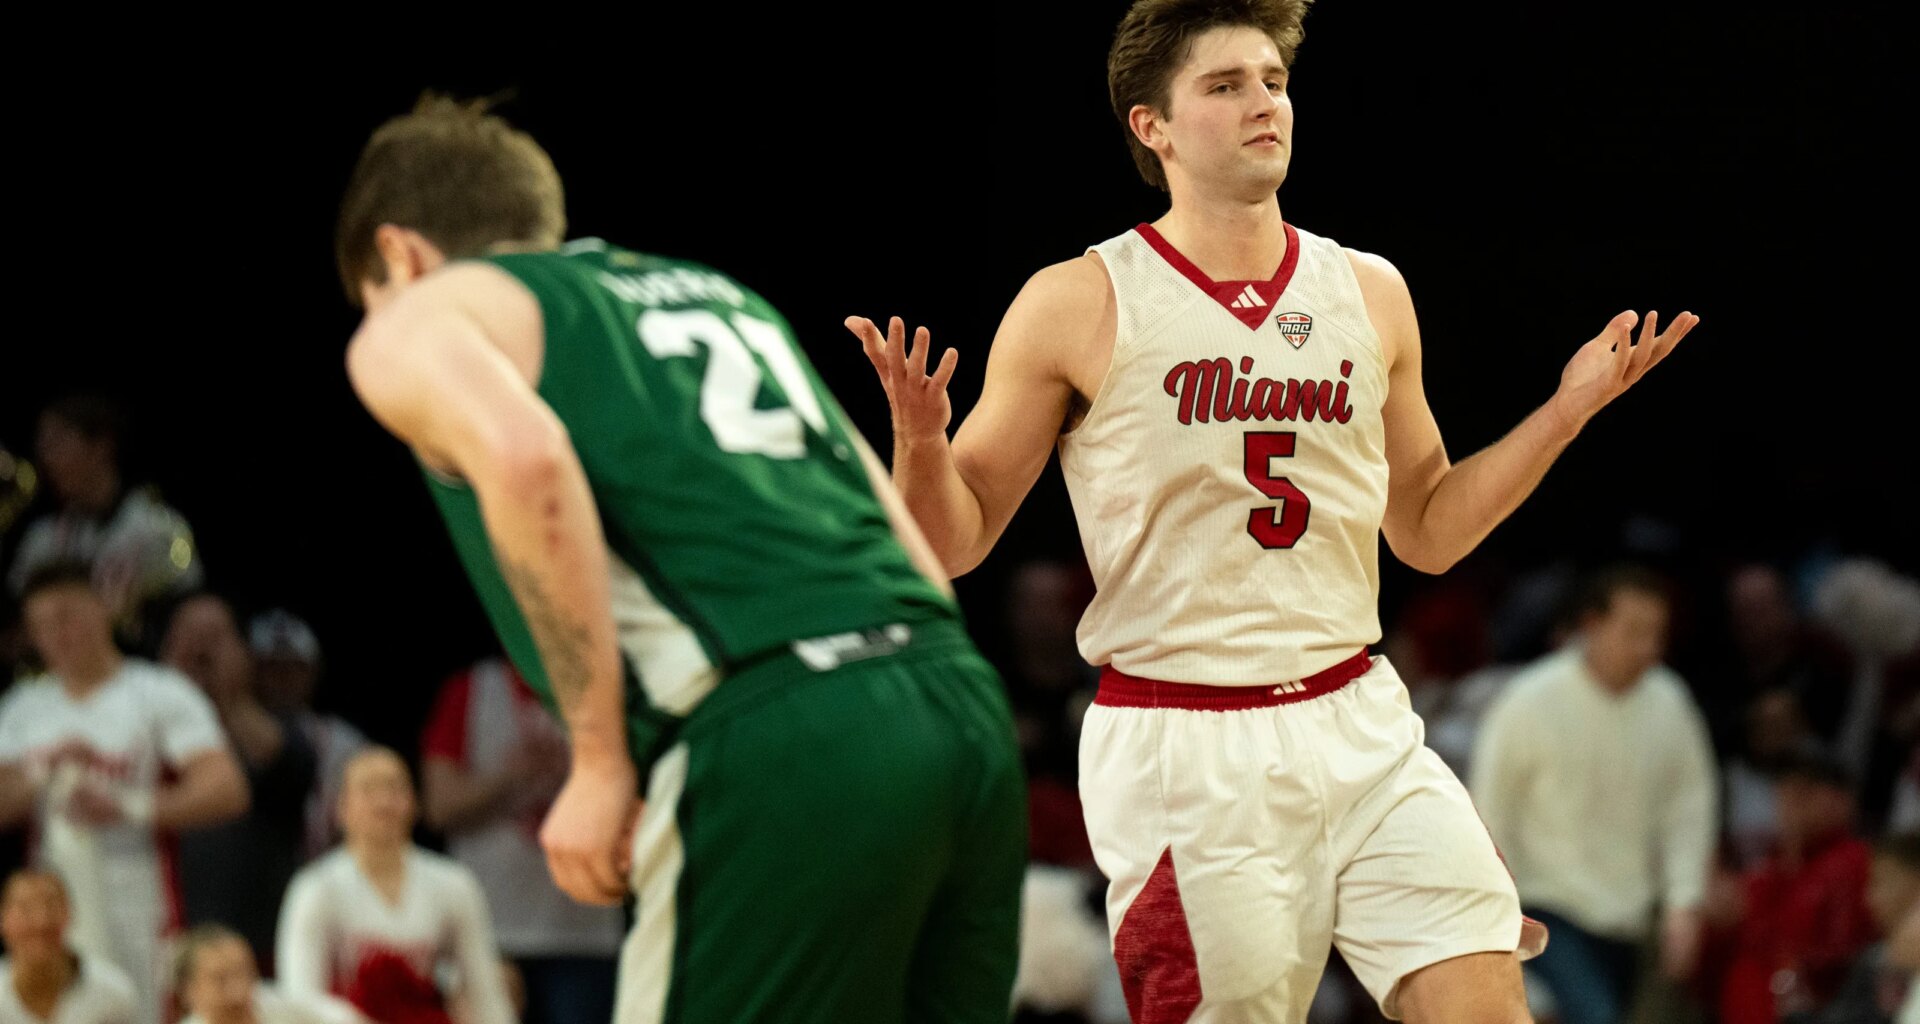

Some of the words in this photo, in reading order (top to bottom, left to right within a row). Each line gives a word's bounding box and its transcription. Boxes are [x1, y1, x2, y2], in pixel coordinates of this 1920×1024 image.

[1280, 323, 1312, 334] MAC
[637, 308, 828, 459] 21
[1164, 355, 1354, 425] Miami
[1243, 431, 1311, 550] 5
